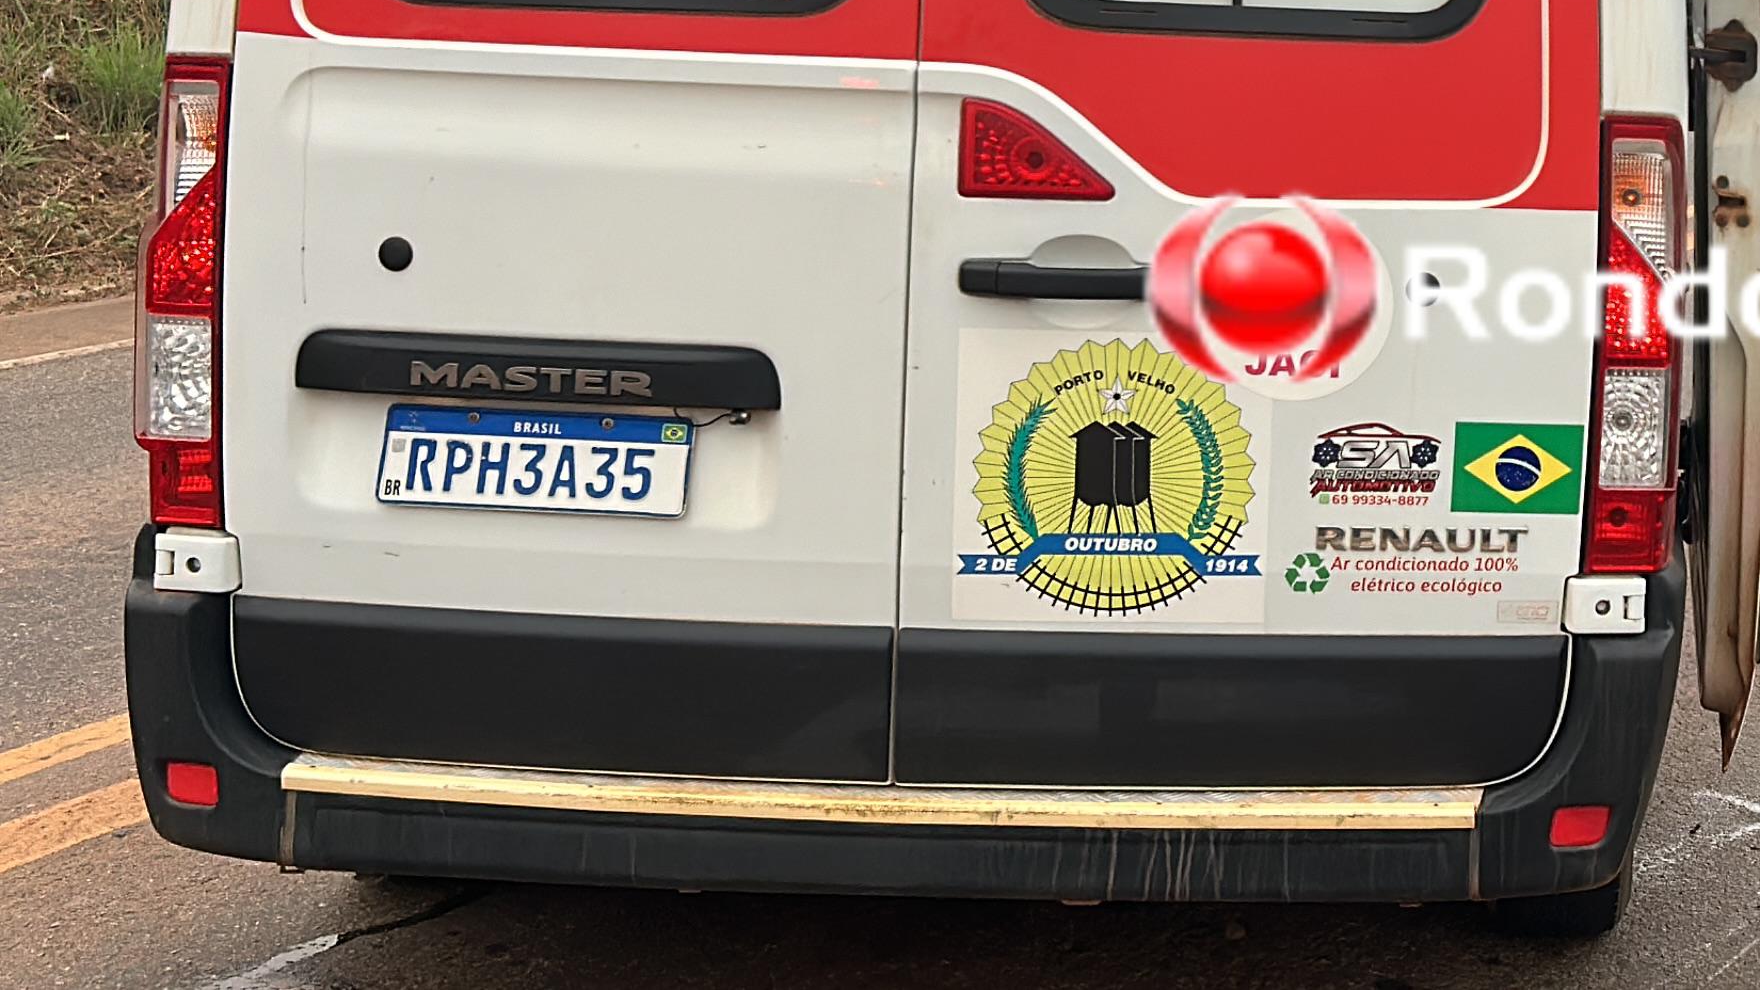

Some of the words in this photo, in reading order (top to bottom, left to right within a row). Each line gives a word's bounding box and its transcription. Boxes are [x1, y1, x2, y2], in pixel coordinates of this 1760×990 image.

[410, 360, 653, 397] MASTER
[1054, 370, 1104, 396] PORTO
[1127, 370, 1177, 396] VELHO
[513, 420, 562, 436] BRASIL
[406, 438, 655, 500] RPH3A35
[1311, 469, 1334, 481] AR
[1335, 469, 1441, 481] CONDICIONADO
[384, 478, 401, 496] BR
[1310, 479, 1437, 496] AUTOMOTIVO
[1332, 494, 1348, 505] 69
[1352, 494, 1429, 506] 99334-8877
[1315, 525, 1529, 553] RENAULT
[975, 558, 988, 572] 2
[991, 558, 1017, 572] DE
[1064, 537, 1158, 552] OUTUBRO
[1205, 558, 1249, 573] 1914
[1331, 556, 1350, 571] Ar
[1355, 556, 1469, 571] condicionado
[1474, 557, 1519, 572] 100%
[1351, 577, 1415, 593] elétrico
[1421, 577, 1502, 596] ecológico
